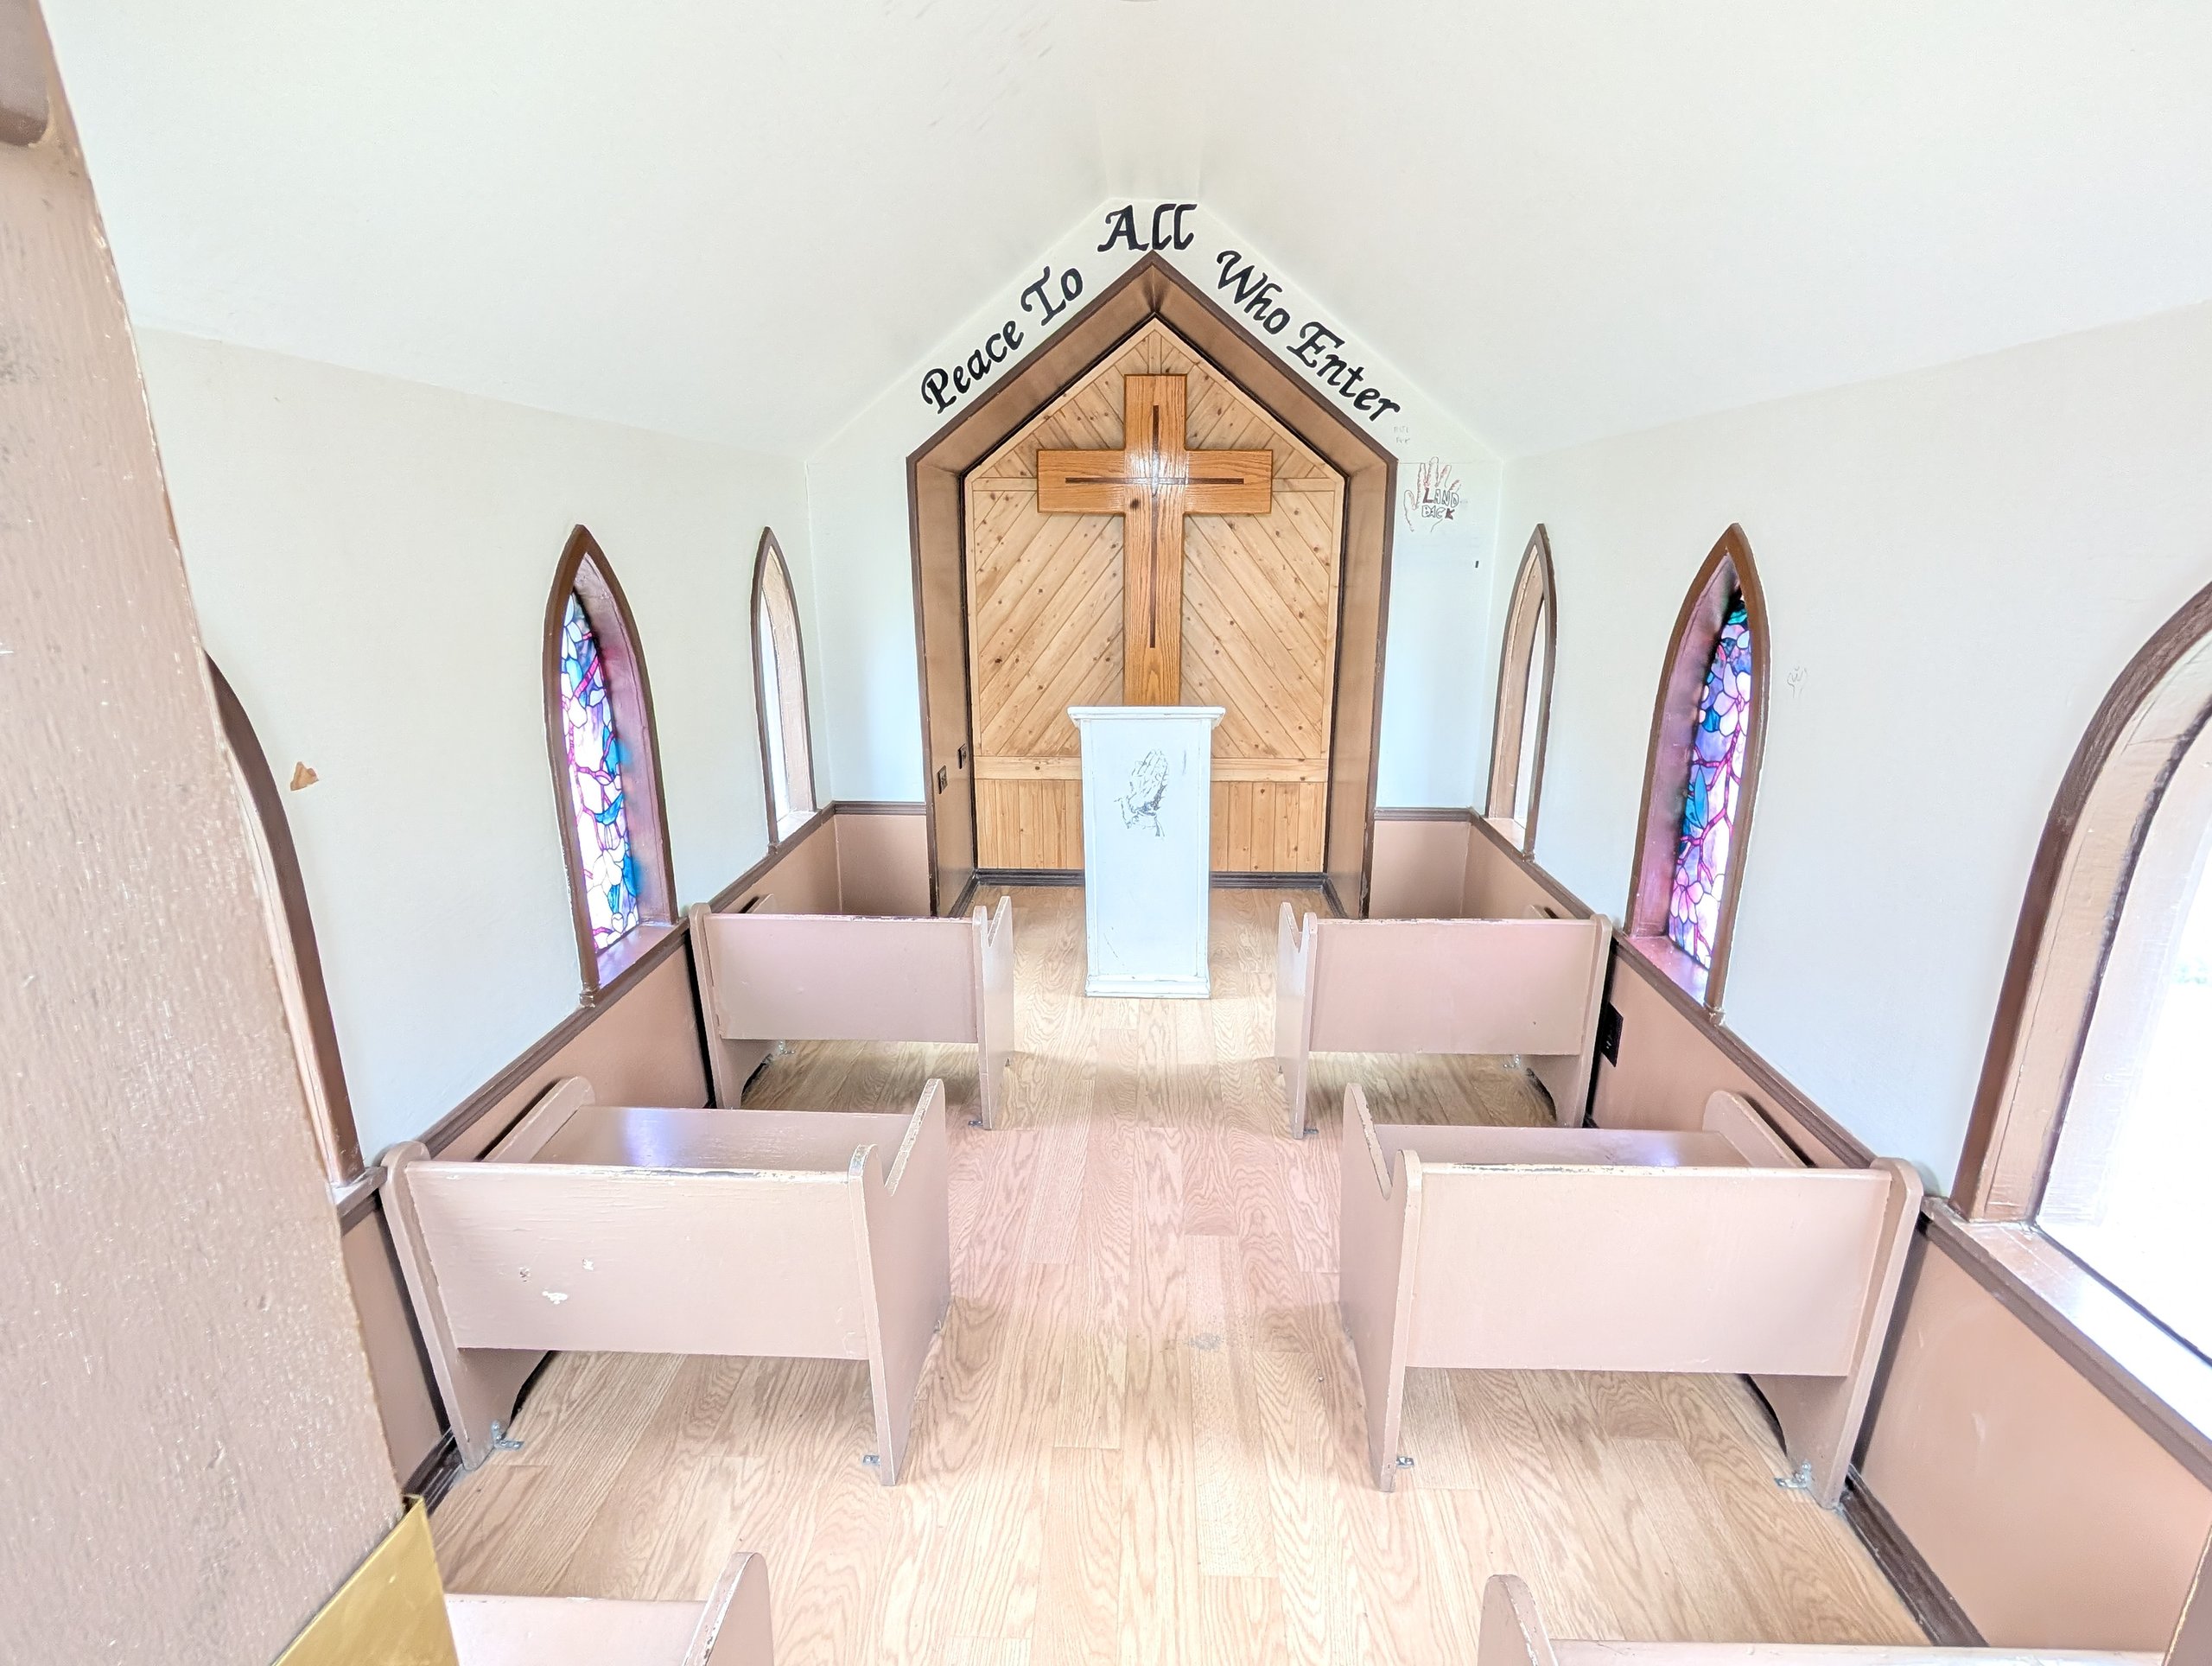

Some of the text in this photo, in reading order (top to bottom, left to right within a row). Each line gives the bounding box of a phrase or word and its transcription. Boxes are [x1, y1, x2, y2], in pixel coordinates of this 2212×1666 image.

[921, 203, 1401, 422] Peace To All Who Enter
[1422, 487, 1459, 508] LAND
[1421, 505, 1455, 520] BACK
